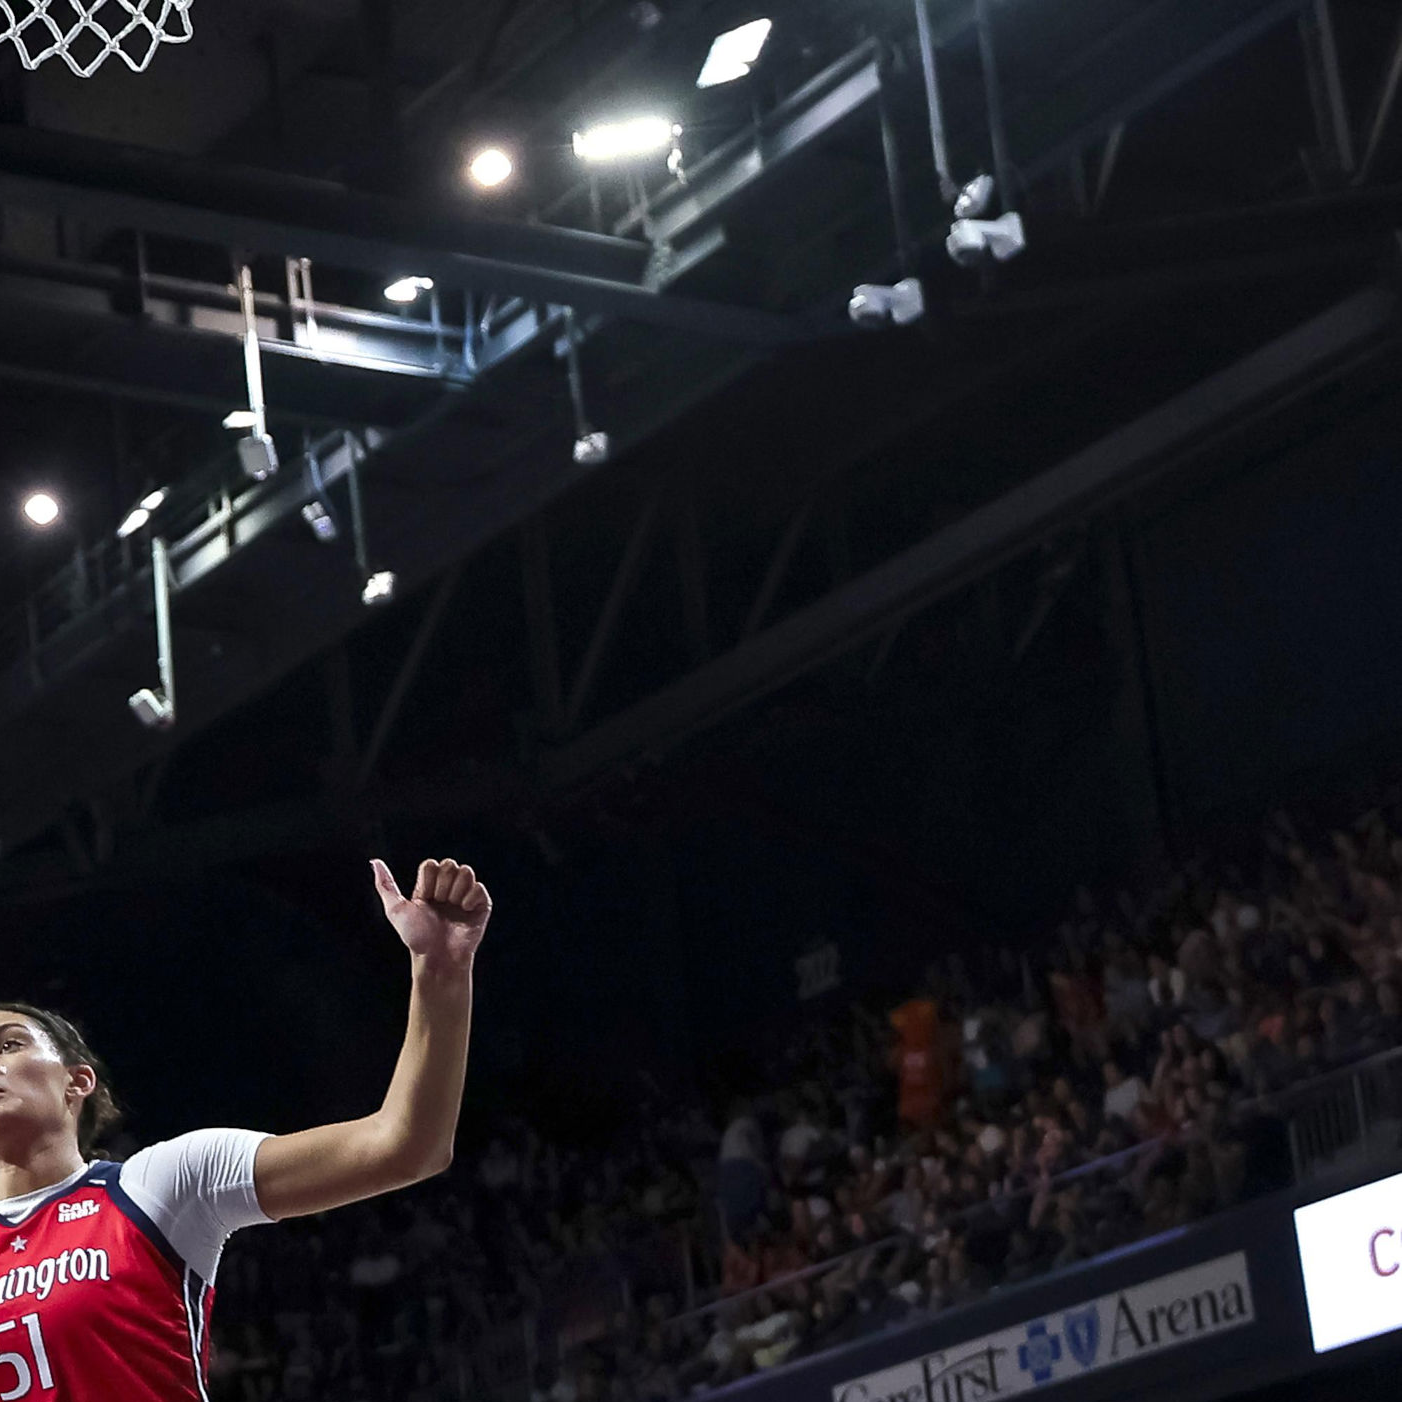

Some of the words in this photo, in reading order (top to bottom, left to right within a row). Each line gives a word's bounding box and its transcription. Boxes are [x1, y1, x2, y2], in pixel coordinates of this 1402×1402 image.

[57, 1199, 95, 1214] CAR
[1369, 1227, 1402, 1278] C
[1110, 1279, 1248, 1358] Arena
